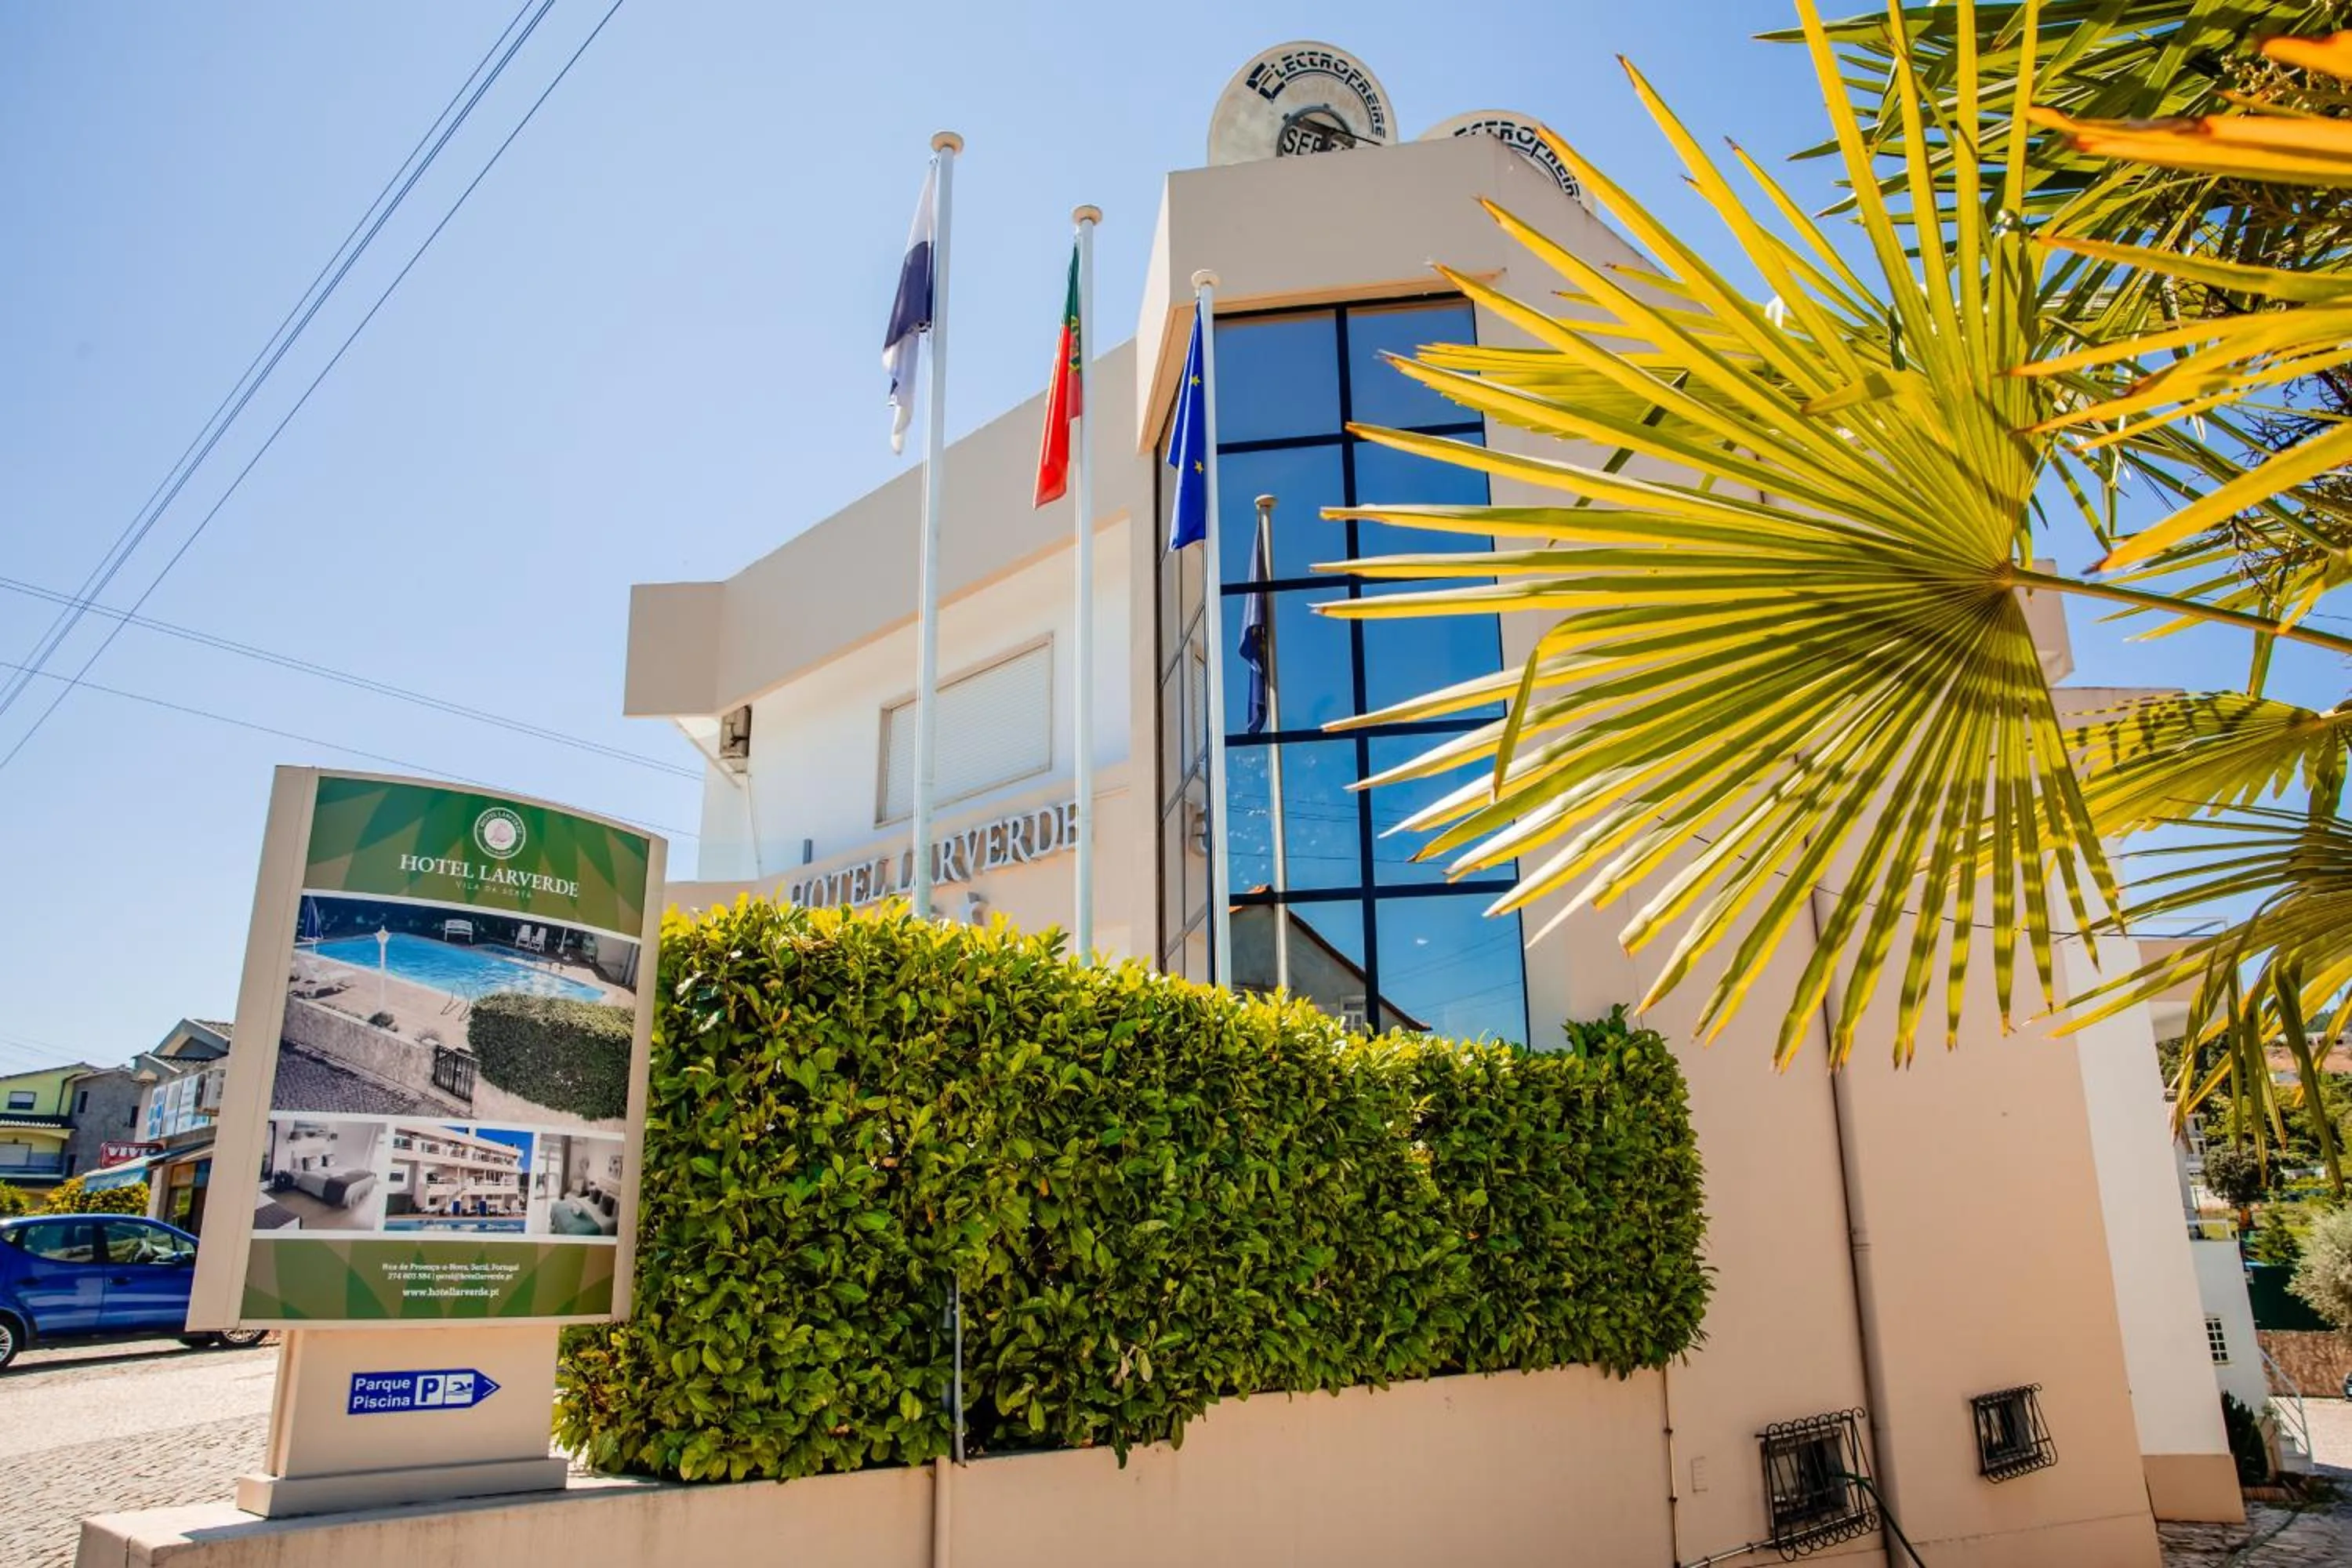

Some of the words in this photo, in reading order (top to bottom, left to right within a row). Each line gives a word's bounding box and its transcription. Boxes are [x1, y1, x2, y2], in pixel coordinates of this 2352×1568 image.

[896, 803, 1078, 894] LRVERDE
[400, 854, 474, 879] HOTEL
[479, 865, 579, 897] LARVERDE
[456, 880, 480, 891] VILA
[492, 1263, 520, 1272] Portugal
[402, 1287, 499, 1298] www.hotellarverde.pt
[354, 1377, 412, 1394] Parque
[420, 1377, 440, 1403] P
[353, 1396, 411, 1409] Piscina
